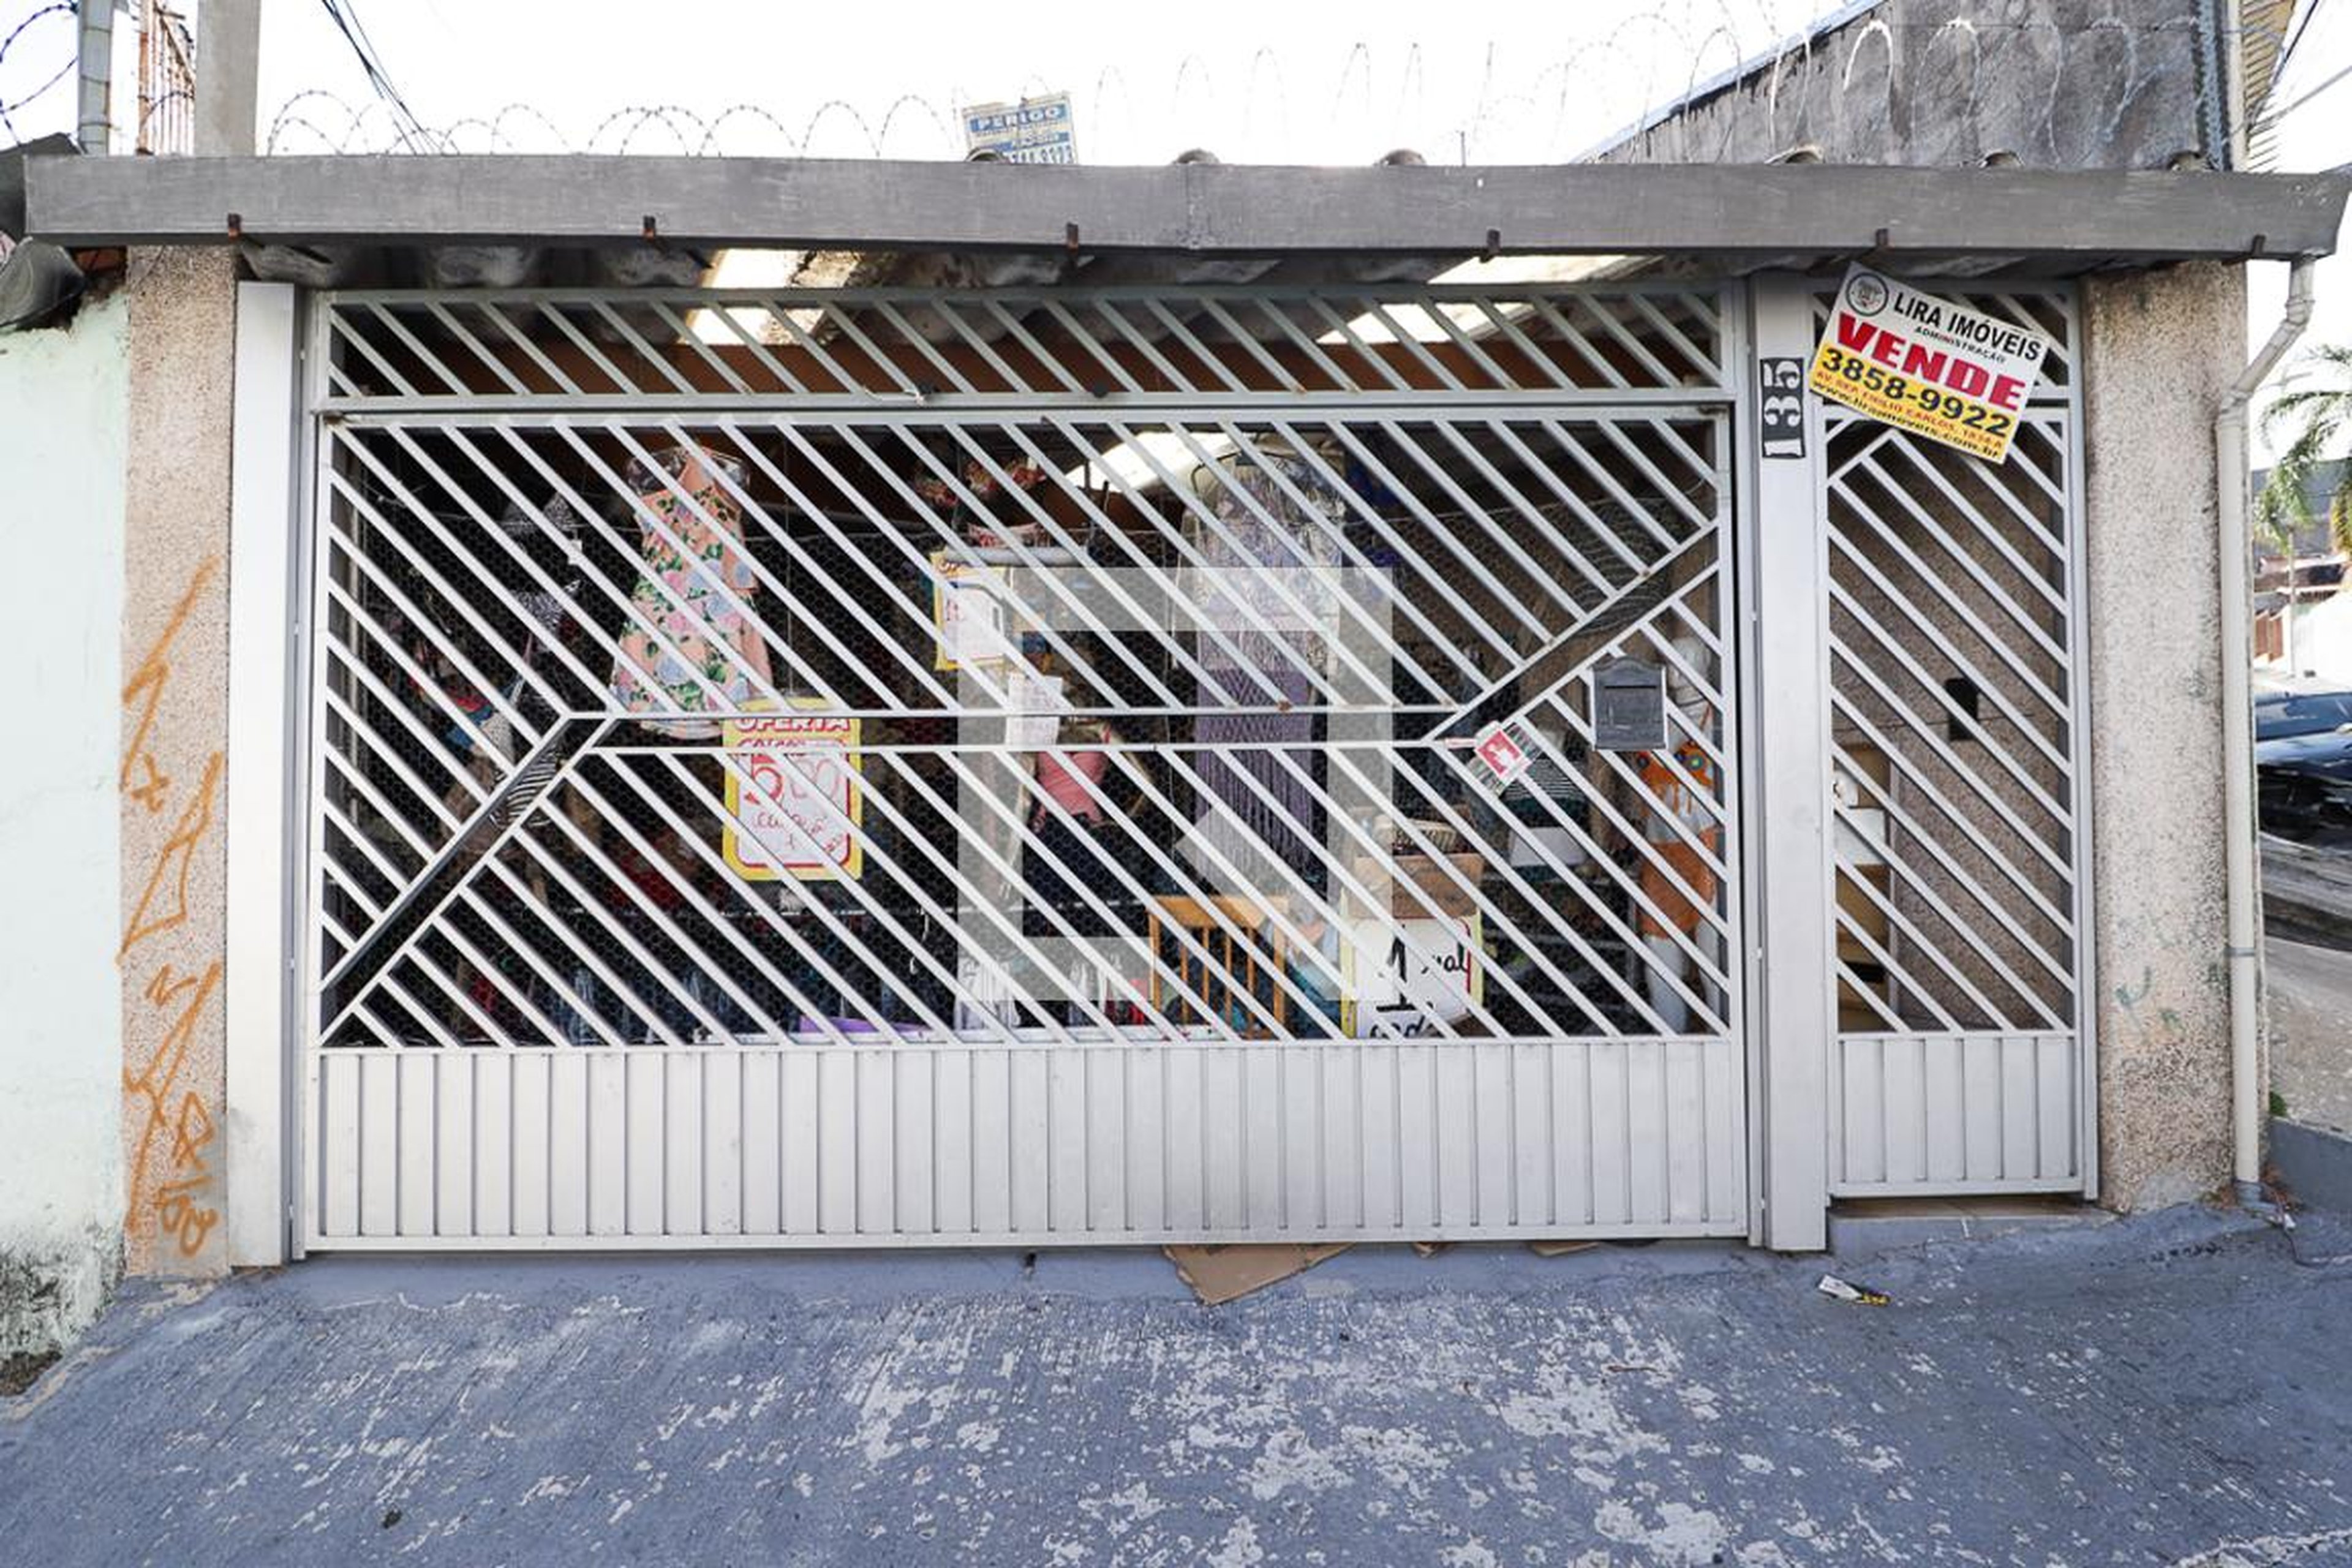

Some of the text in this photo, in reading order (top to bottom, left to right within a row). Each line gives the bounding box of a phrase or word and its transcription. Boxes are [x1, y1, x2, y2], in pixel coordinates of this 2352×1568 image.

[1838, 312, 2026, 412] VENDE
[1894, 293, 1940, 328] LIRA
[1948, 313, 2042, 361] IMÓVEIS
[1821, 348, 2011, 438] 3858-9922
[735, 718, 850, 732] OFERTA
